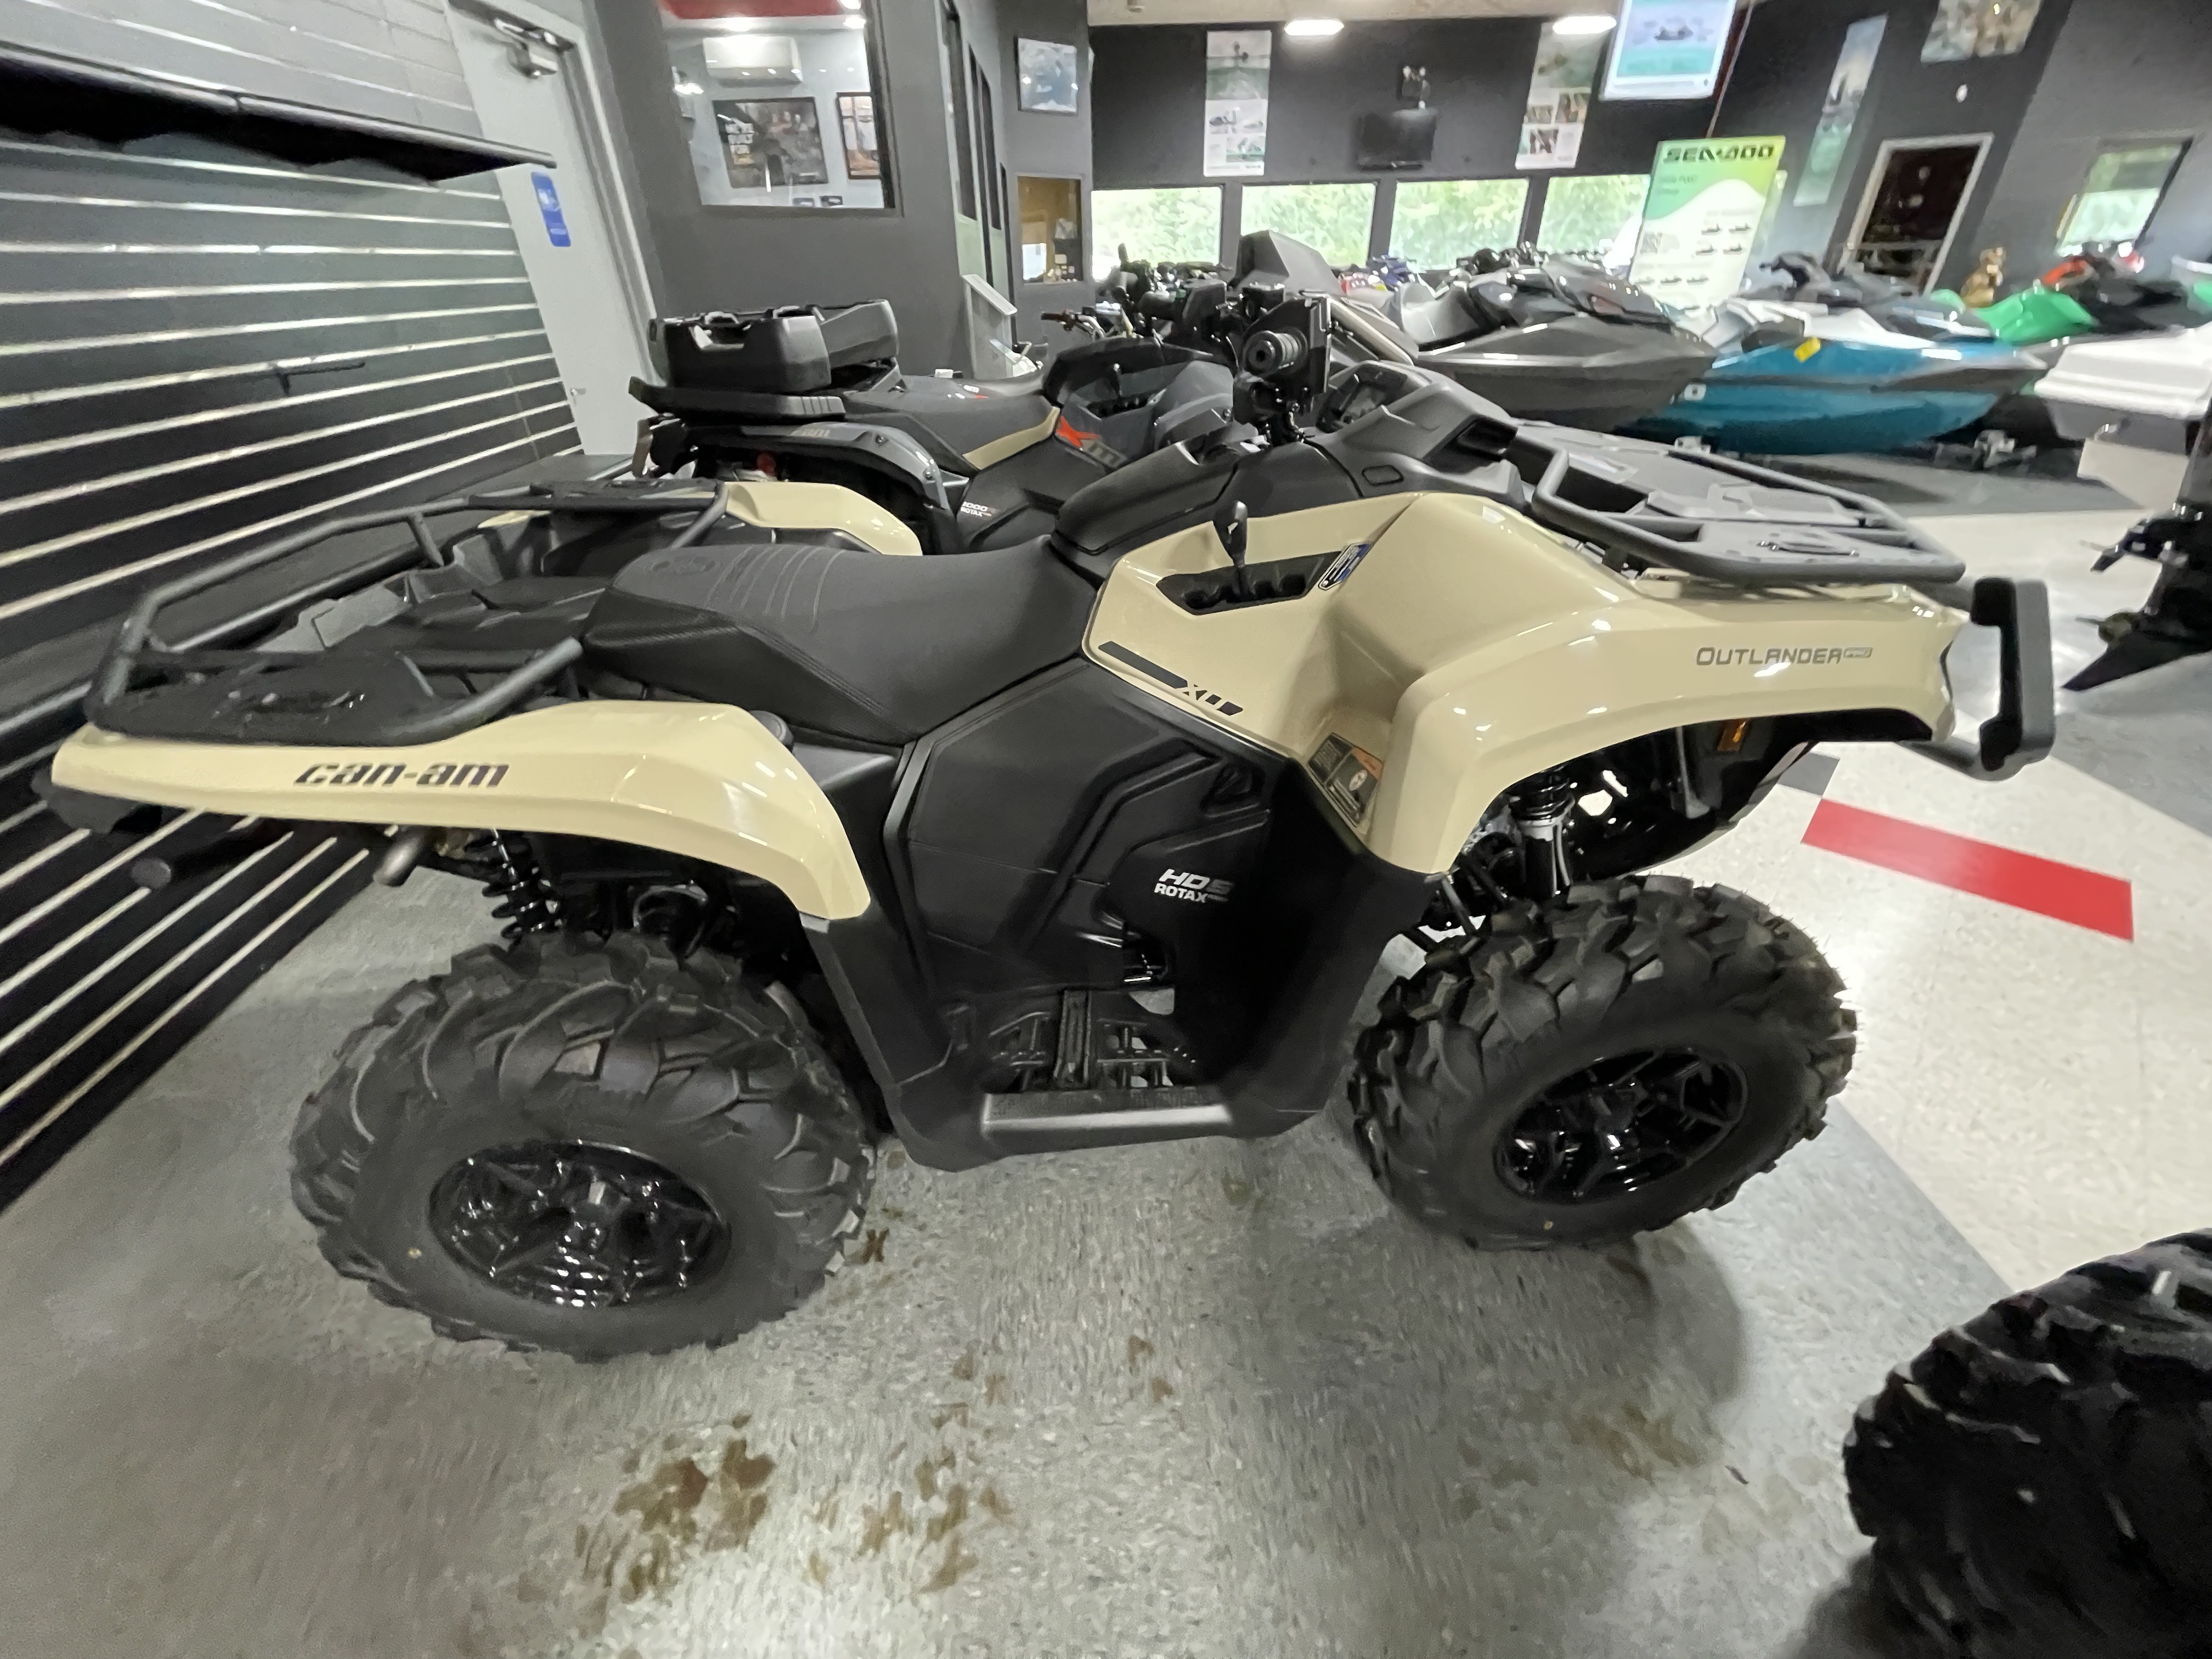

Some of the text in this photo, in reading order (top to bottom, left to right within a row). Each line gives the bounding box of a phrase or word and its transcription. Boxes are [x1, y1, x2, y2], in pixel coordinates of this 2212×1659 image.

[1696, 647, 1842, 665] OUTLANDER
[292, 762, 510, 788] can-am
[1154, 883, 1208, 903] ROTAX
